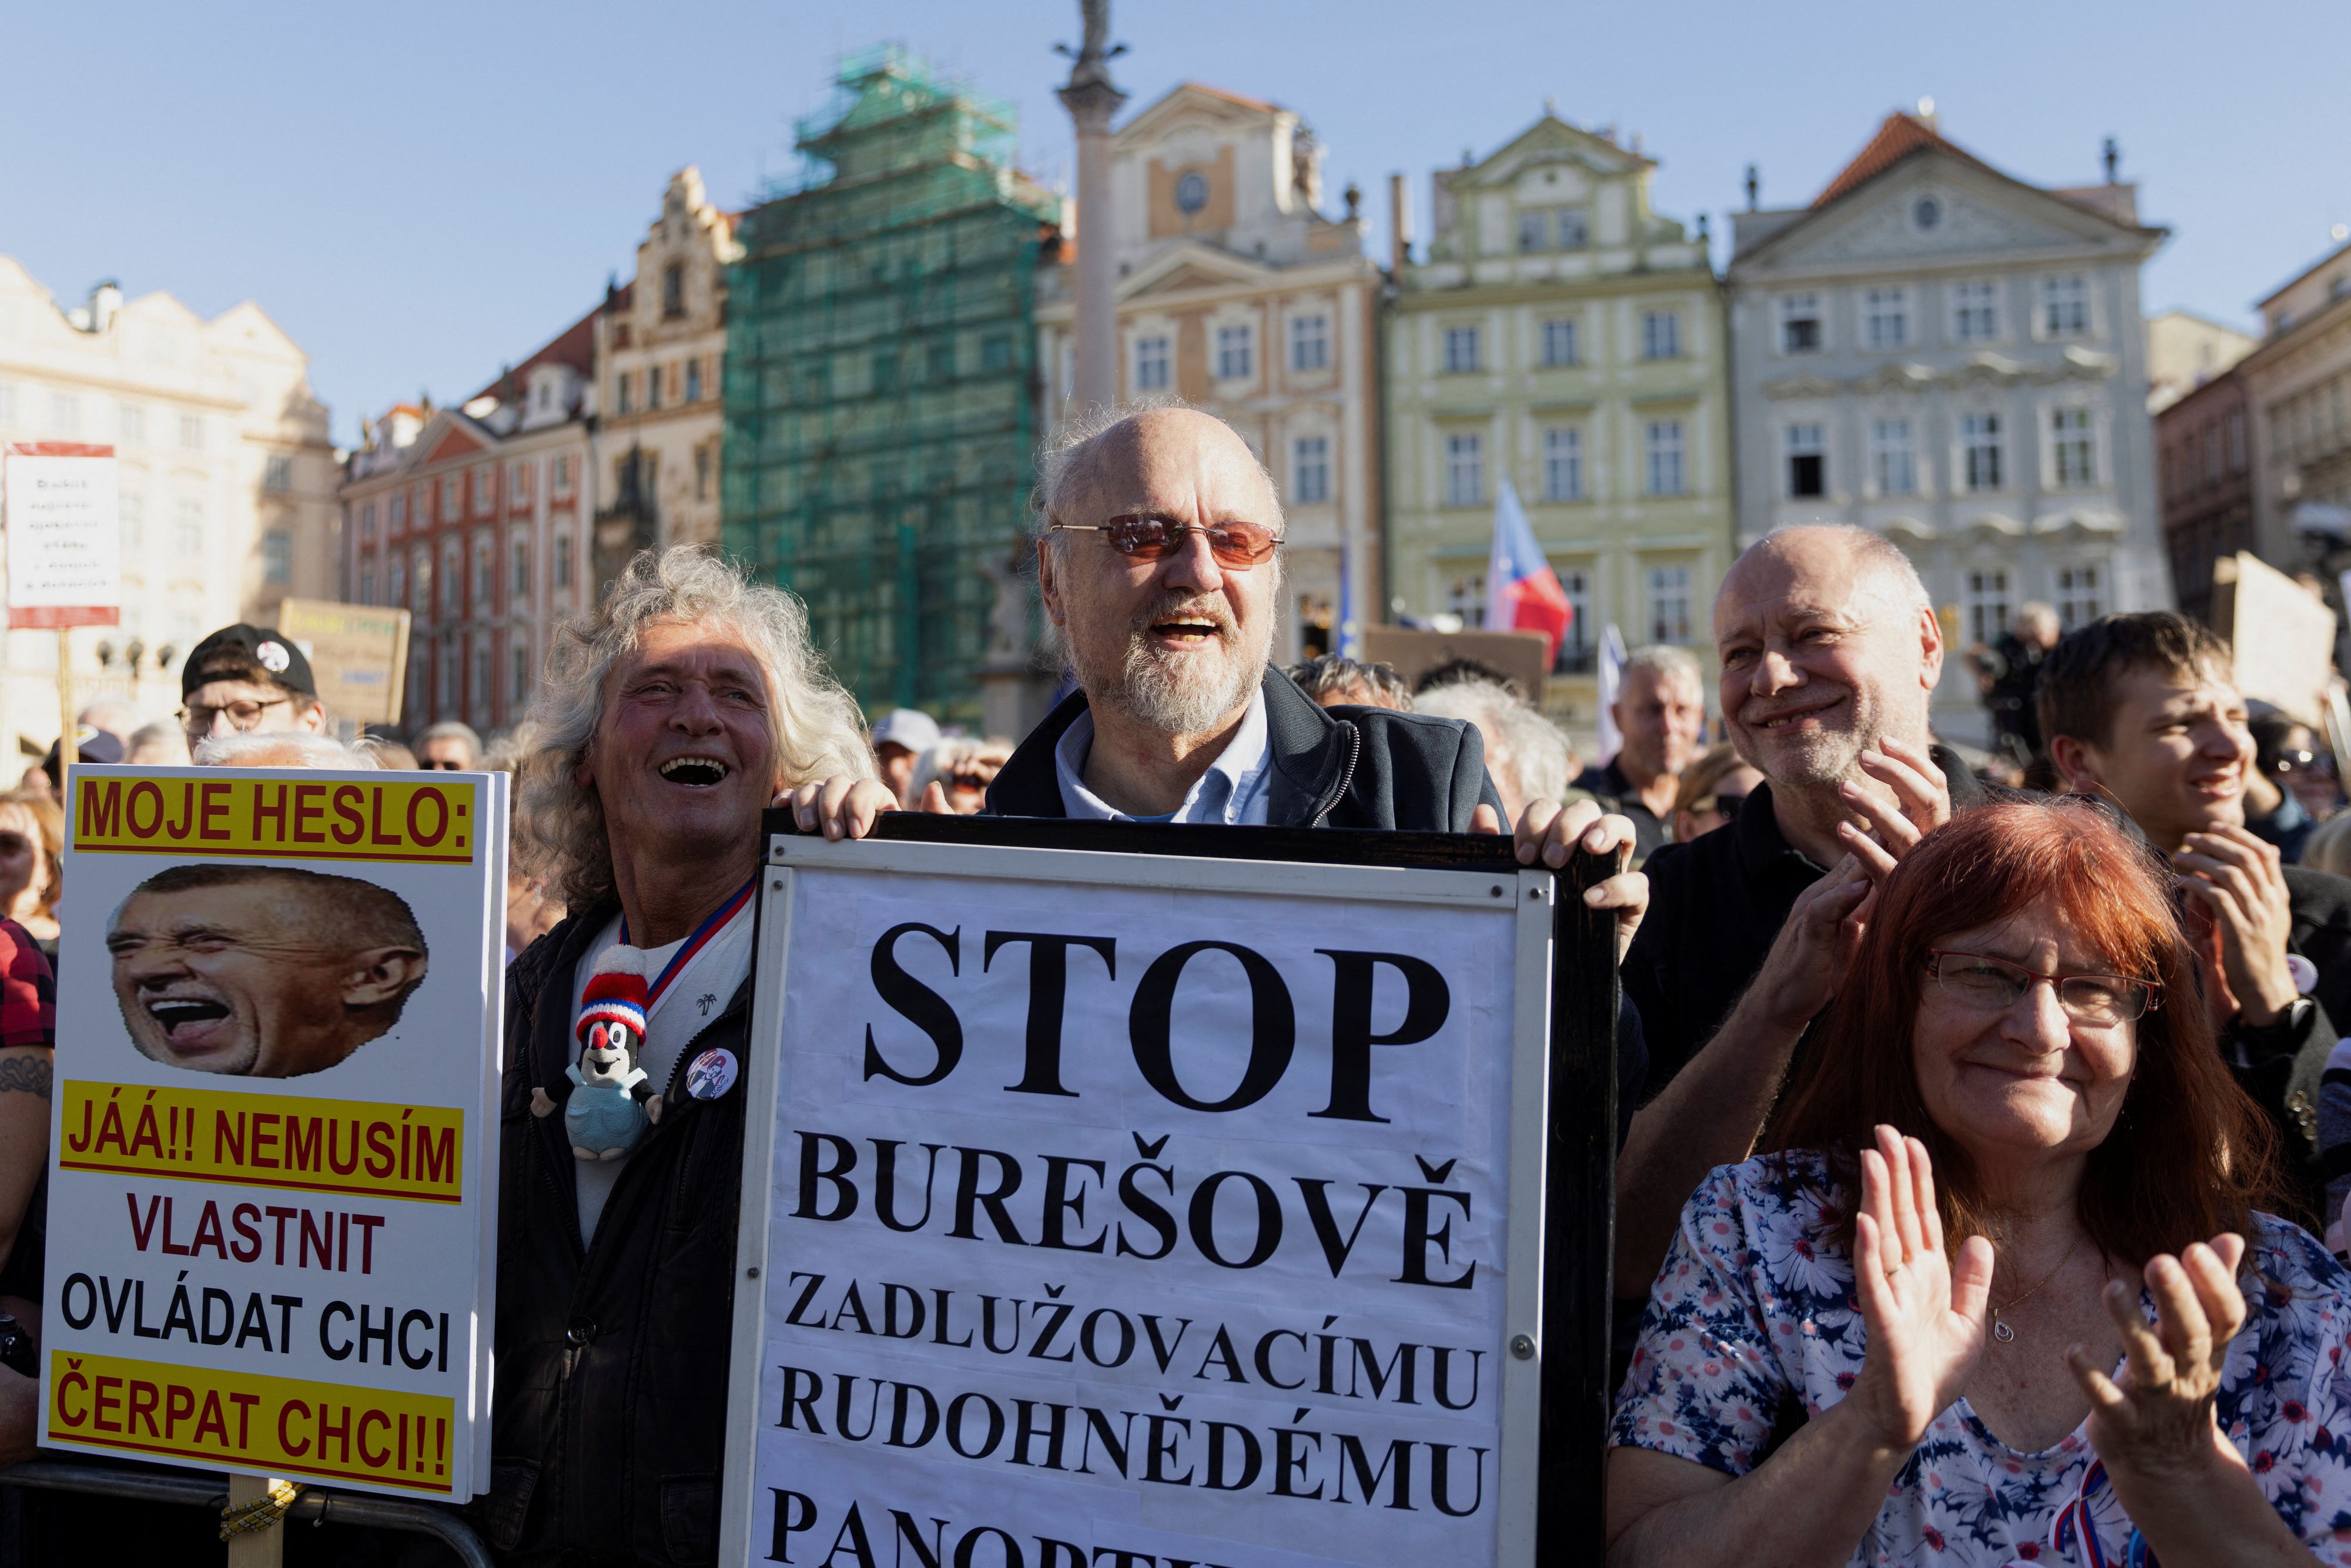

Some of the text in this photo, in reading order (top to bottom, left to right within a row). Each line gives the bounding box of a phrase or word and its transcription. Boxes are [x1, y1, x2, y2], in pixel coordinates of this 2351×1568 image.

[82, 780, 467, 847] MOJE HESLO:
[864, 922, 1450, 1124] STOP
[68, 1086, 456, 1184] JÁÁ!! NEMUSÍM
[126, 1192, 385, 1274] VLASTNIT
[788, 1130, 1476, 1289] BUREŠOVĚ
[61, 1270, 449, 1372] OVLÁDAT CHCI
[785, 1271, 1486, 1410] ZADLUŽOVACÍMU
[57, 1358, 446, 1476] ČERPAT CHCI!!
[773, 1365, 1491, 1517] RUDOHNĚDÉMU
